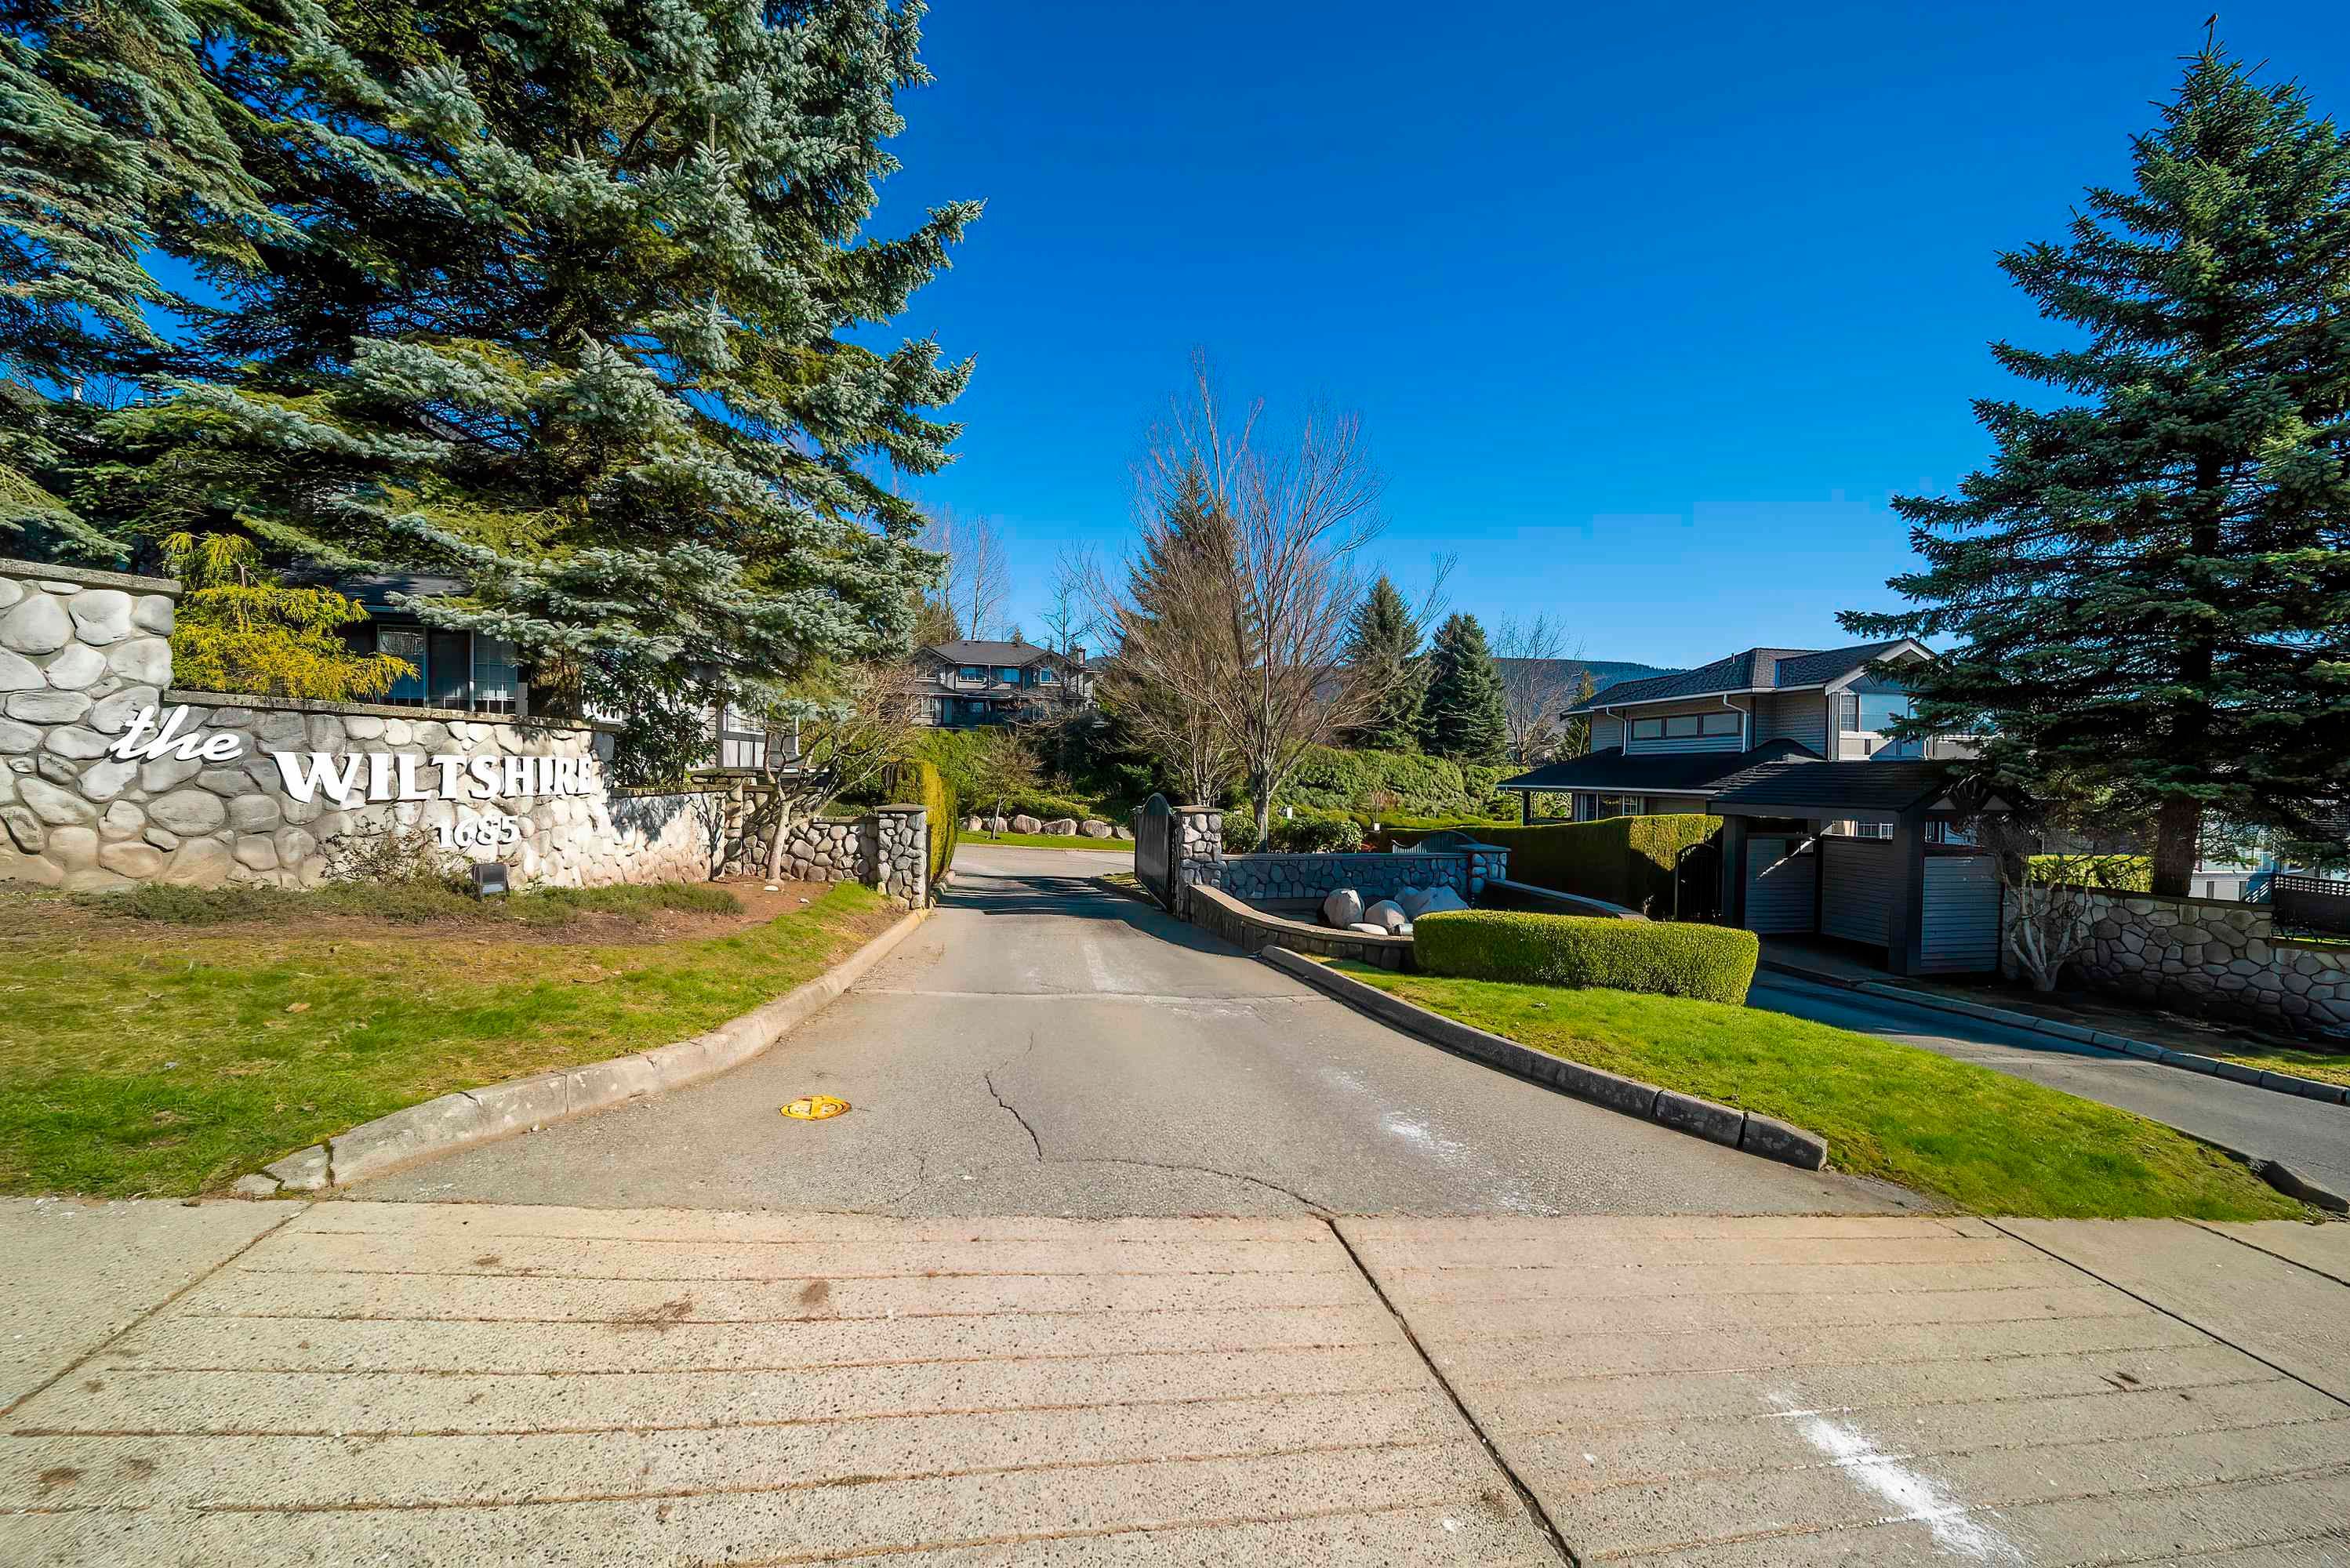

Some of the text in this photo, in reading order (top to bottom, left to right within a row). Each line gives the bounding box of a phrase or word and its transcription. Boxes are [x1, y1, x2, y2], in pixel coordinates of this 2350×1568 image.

[108, 705, 593, 804] the WILTSHIRE
[433, 815, 521, 848] 1685
